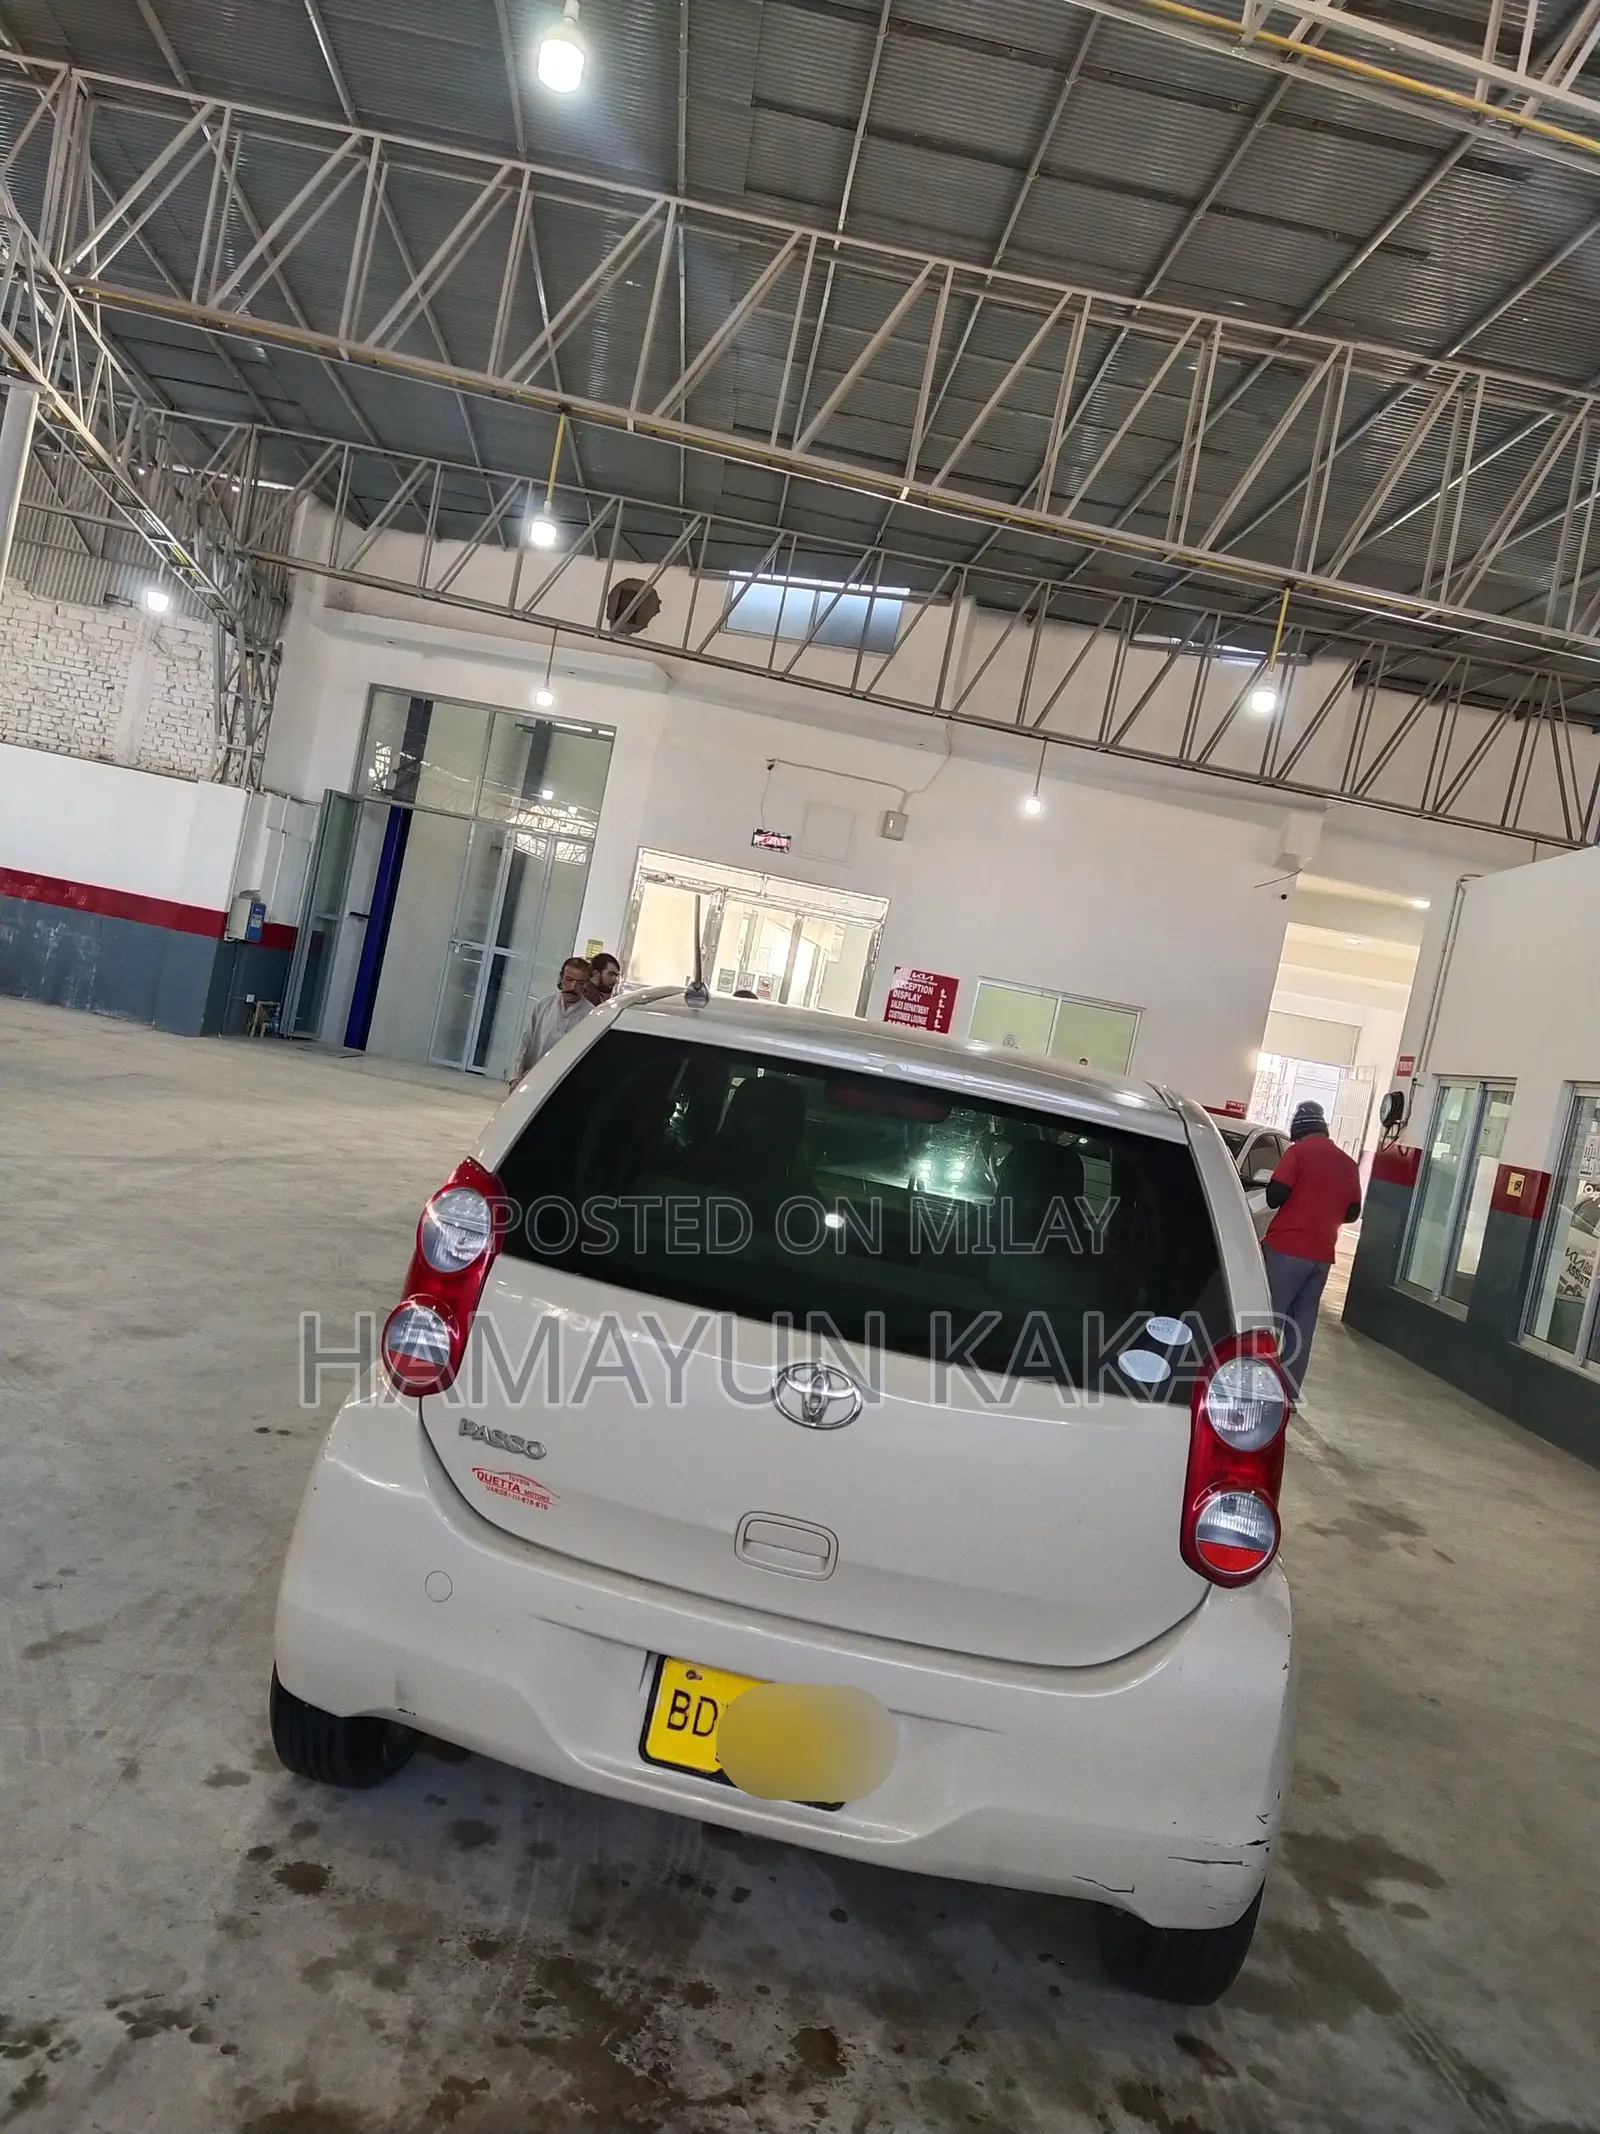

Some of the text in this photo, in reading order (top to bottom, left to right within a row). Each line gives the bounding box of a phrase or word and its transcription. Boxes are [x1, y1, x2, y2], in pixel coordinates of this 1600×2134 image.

[895, 980, 934, 995] RECEPTION
[893, 989, 921, 1002] DISPLAY
[890, 999, 929, 1015] SALES DEPARTMENT
[888, 1010, 910, 1021] CUSTOMER
[911, 1014, 927, 1025] LOUNGE
[459, 1418, 547, 1460] PASSO
[477, 1471, 550, 1502] QUETTA MOTORS
[509, 1475, 530, 1486] TOYOTA
